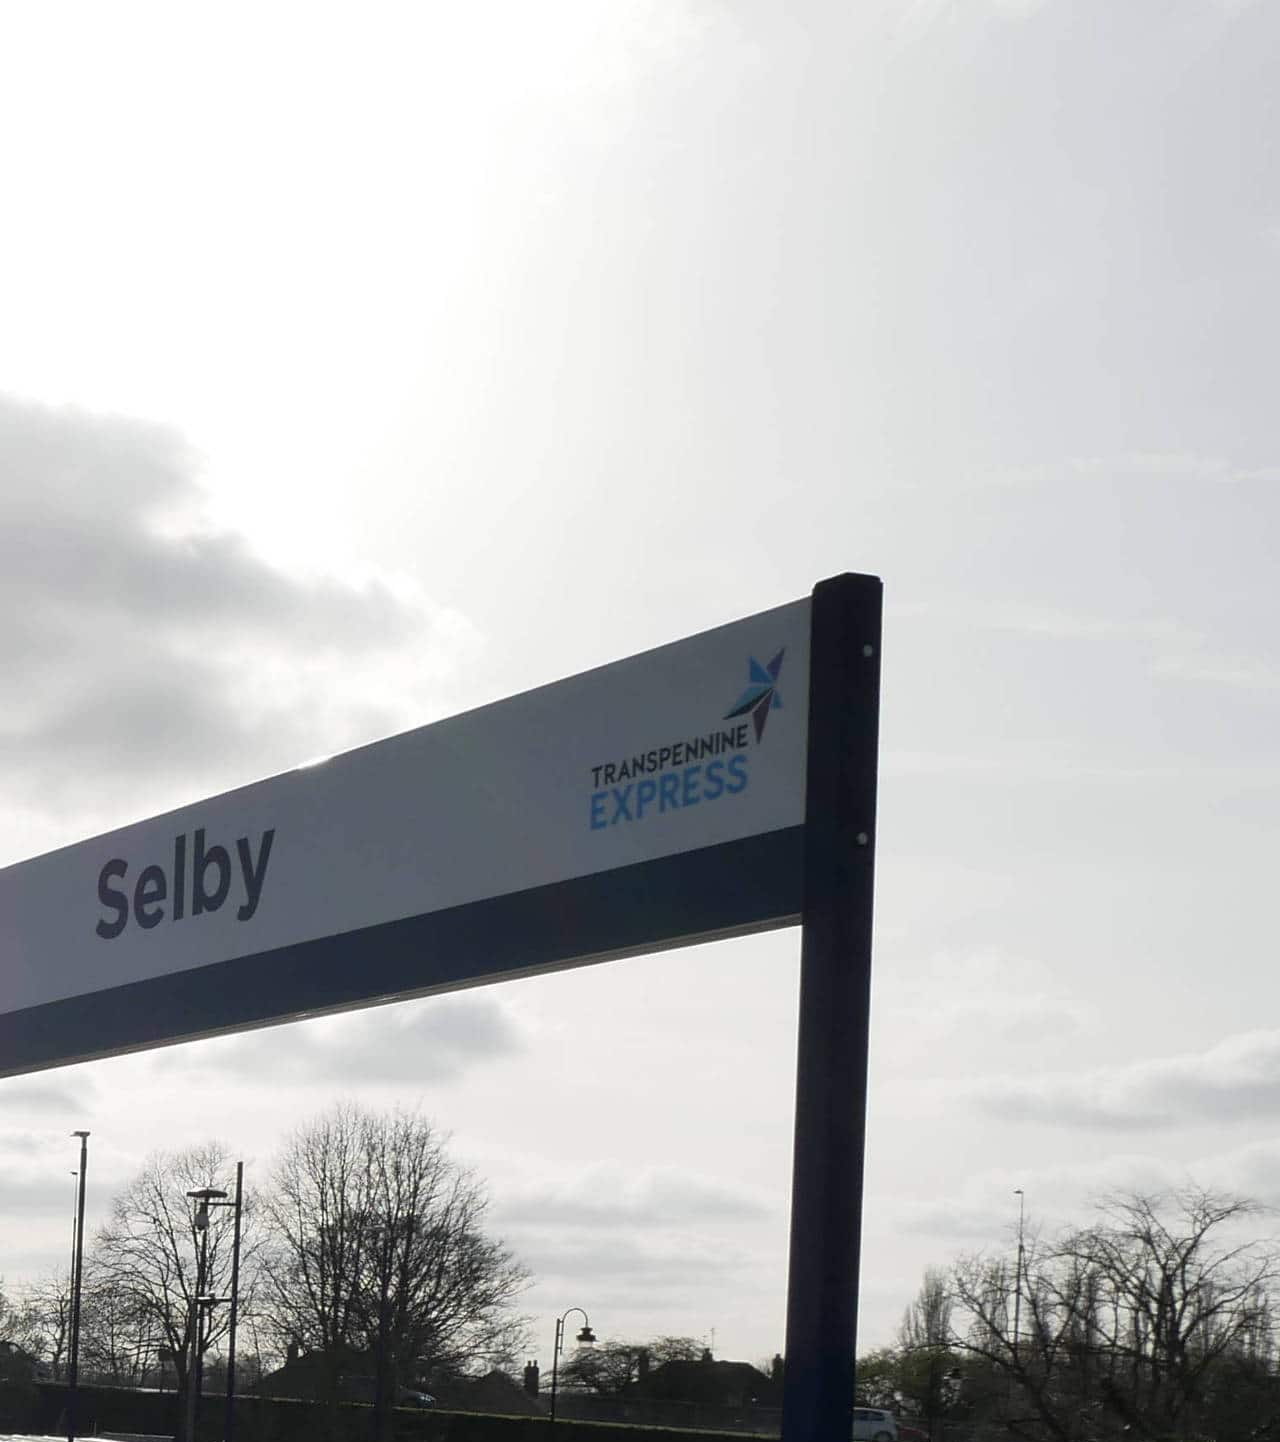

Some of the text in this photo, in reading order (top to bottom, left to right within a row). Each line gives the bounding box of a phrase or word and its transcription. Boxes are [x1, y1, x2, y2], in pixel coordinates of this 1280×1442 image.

[590, 754, 749, 830] EXPRESS
[591, 724, 749, 788] TRANSPENNINE
[95, 827, 276, 940] Selby
